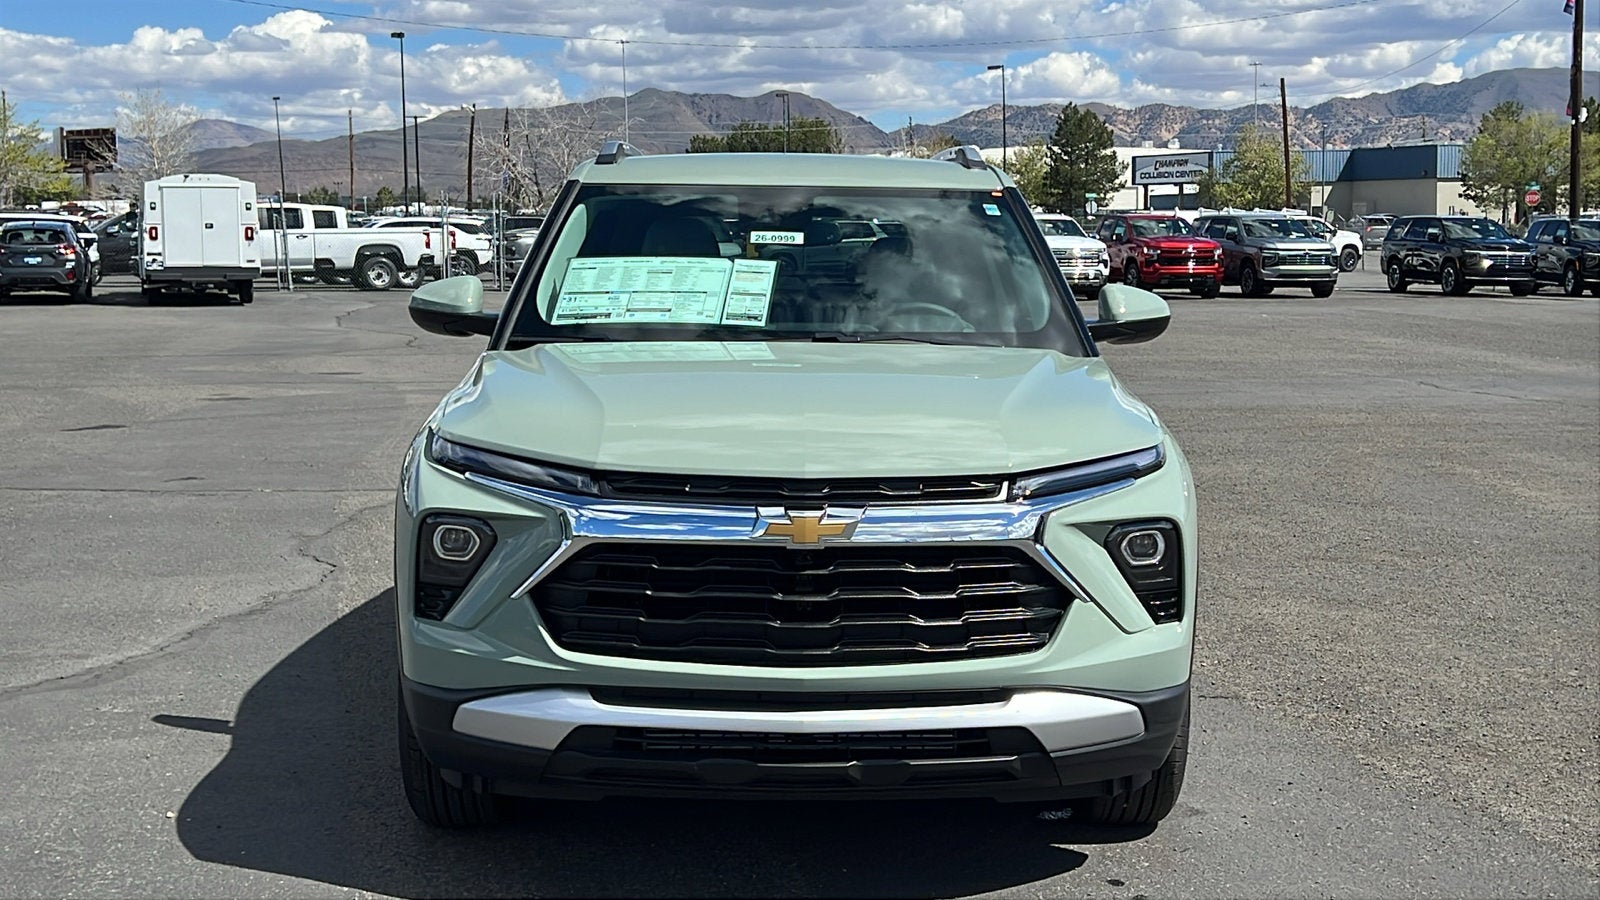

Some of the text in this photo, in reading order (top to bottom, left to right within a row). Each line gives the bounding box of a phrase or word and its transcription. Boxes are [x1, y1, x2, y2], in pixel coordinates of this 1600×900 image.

[1154, 158, 1189, 170] CHAMPION
[1140, 171, 1174, 179] COLLISION
[754, 234, 796, 242] 26-0999
